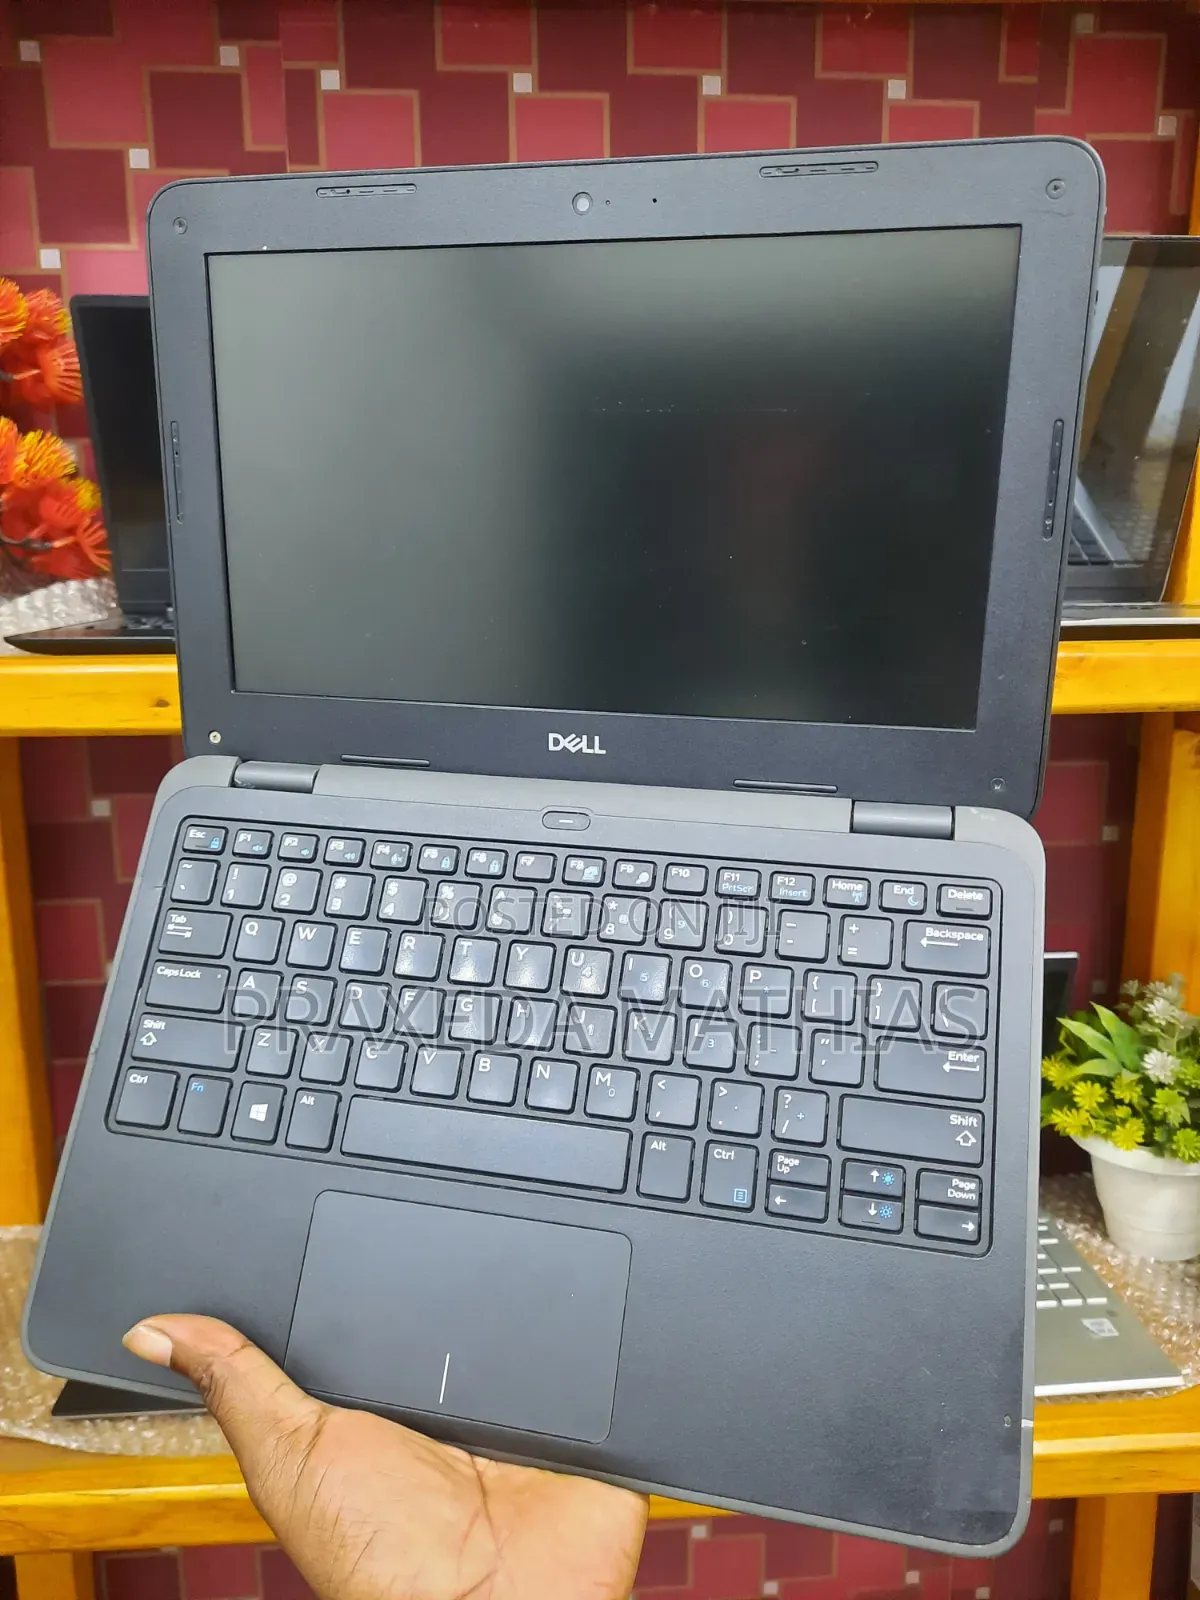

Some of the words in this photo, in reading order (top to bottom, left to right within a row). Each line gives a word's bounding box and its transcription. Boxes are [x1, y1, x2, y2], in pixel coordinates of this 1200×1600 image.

[548, 732, 607, 755] DELL
[189, 829, 206, 839] Esc
[238, 833, 252, 842] F1
[284, 837, 298, 847] F2
[376, 844, 390, 855] F4
[281, 872, 298, 887] @
[671, 868, 690, 878] F10
[723, 872, 740, 882] F11
[722, 883, 753, 893] PrtScr
[777, 876, 796, 887] F12
[832, 880, 864, 891] Home
[227, 889, 235, 900] 1
[779, 888, 808, 898] Insert
[893, 885, 915, 896] End
[947, 888, 984, 901] Delete
[280, 893, 291, 906] 2
[381, 903, 395, 916] 4
[170, 914, 187, 924] Tab
[244, 921, 260, 936] Q
[298, 926, 317, 941] W
[605, 923, 616, 936] 8
[663, 928, 674, 940] 9
[925, 927, 984, 942] Backspace
[350, 931, 363, 945] E
[403, 936, 417, 950] R
[460, 941, 473, 955] T
[516, 947, 529, 961] Y
[571, 951, 585, 966] U
[157, 966, 180, 978] Caps
[180, 969, 202, 979] Lock
[689, 963, 703, 978] O
[749, 969, 762, 984] P
[243, 975, 256, 989] A
[296, 981, 308, 994] S
[350, 986, 362, 1000] D
[460, 998, 474, 1012] G
[516, 1003, 530, 1018] H
[143, 1019, 166, 1030] Shift
[257, 1032, 273, 1047] Z
[311, 1037, 326, 1053] X
[707, 1038, 715, 1048] 3
[366, 1045, 378, 1060] C
[423, 1050, 437, 1065] V
[948, 1051, 980, 1063] Enter
[478, 1057, 491, 1072] B
[536, 1064, 551, 1079] N
[129, 1074, 149, 1085] Ctrl
[595, 1071, 612, 1087] M
[190, 1082, 204, 1093] Fn
[300, 1095, 315, 1106] Alt
[783, 1094, 792, 1109] ?
[949, 1114, 978, 1128] Shift
[650, 1140, 666, 1151] Alt
[713, 1149, 735, 1161] Ctrl
[777, 1155, 800, 1167] Page
[777, 1164, 790, 1174] Up
[952, 1178, 976, 1191] Page
[947, 1188, 976, 1201] Down
